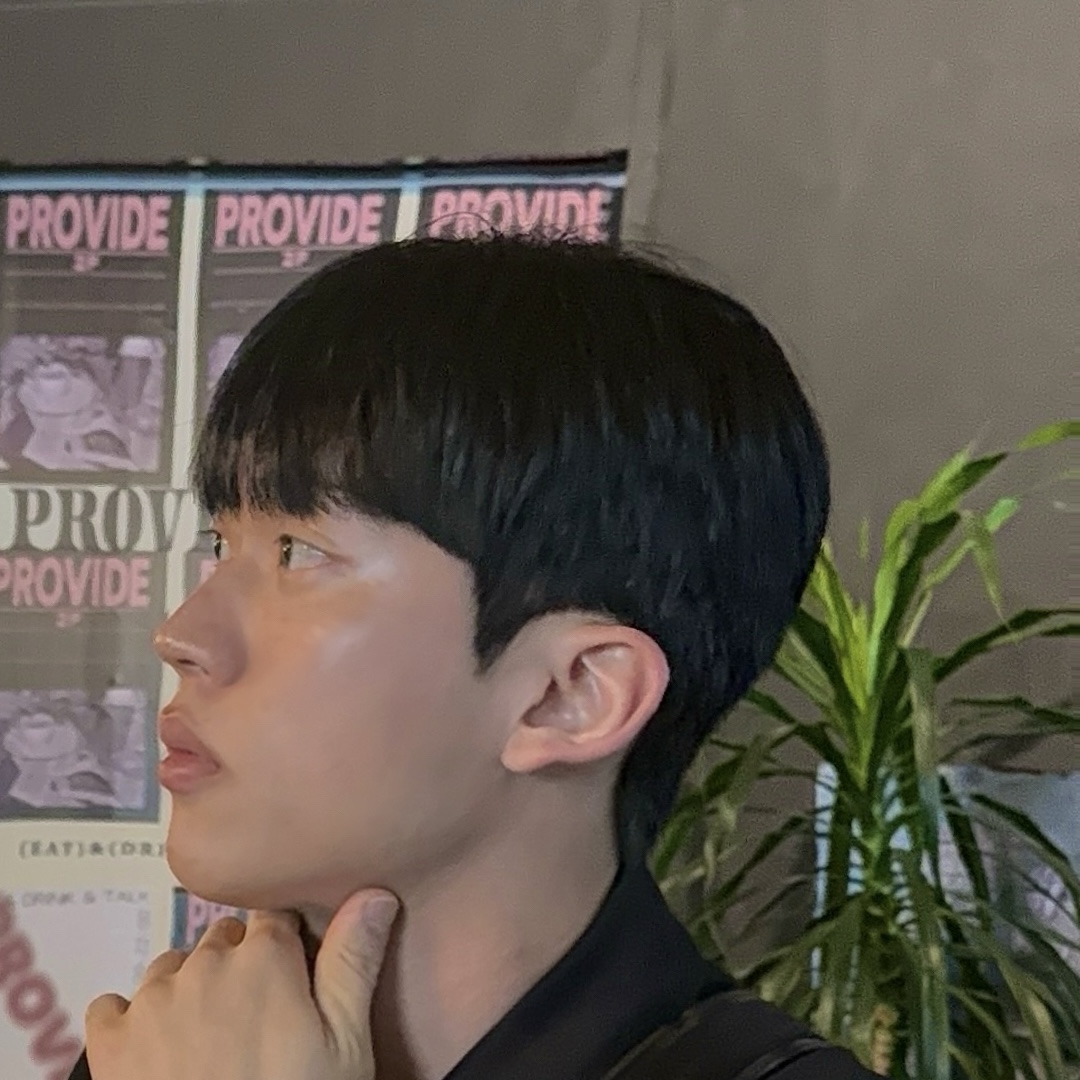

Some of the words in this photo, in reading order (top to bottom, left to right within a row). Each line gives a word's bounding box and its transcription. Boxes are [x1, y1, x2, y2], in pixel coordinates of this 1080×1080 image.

[6, 194, 170, 251] PROVIDE
[214, 192, 385, 246] PROVIDE
[8, 484, 200, 552] PROV
